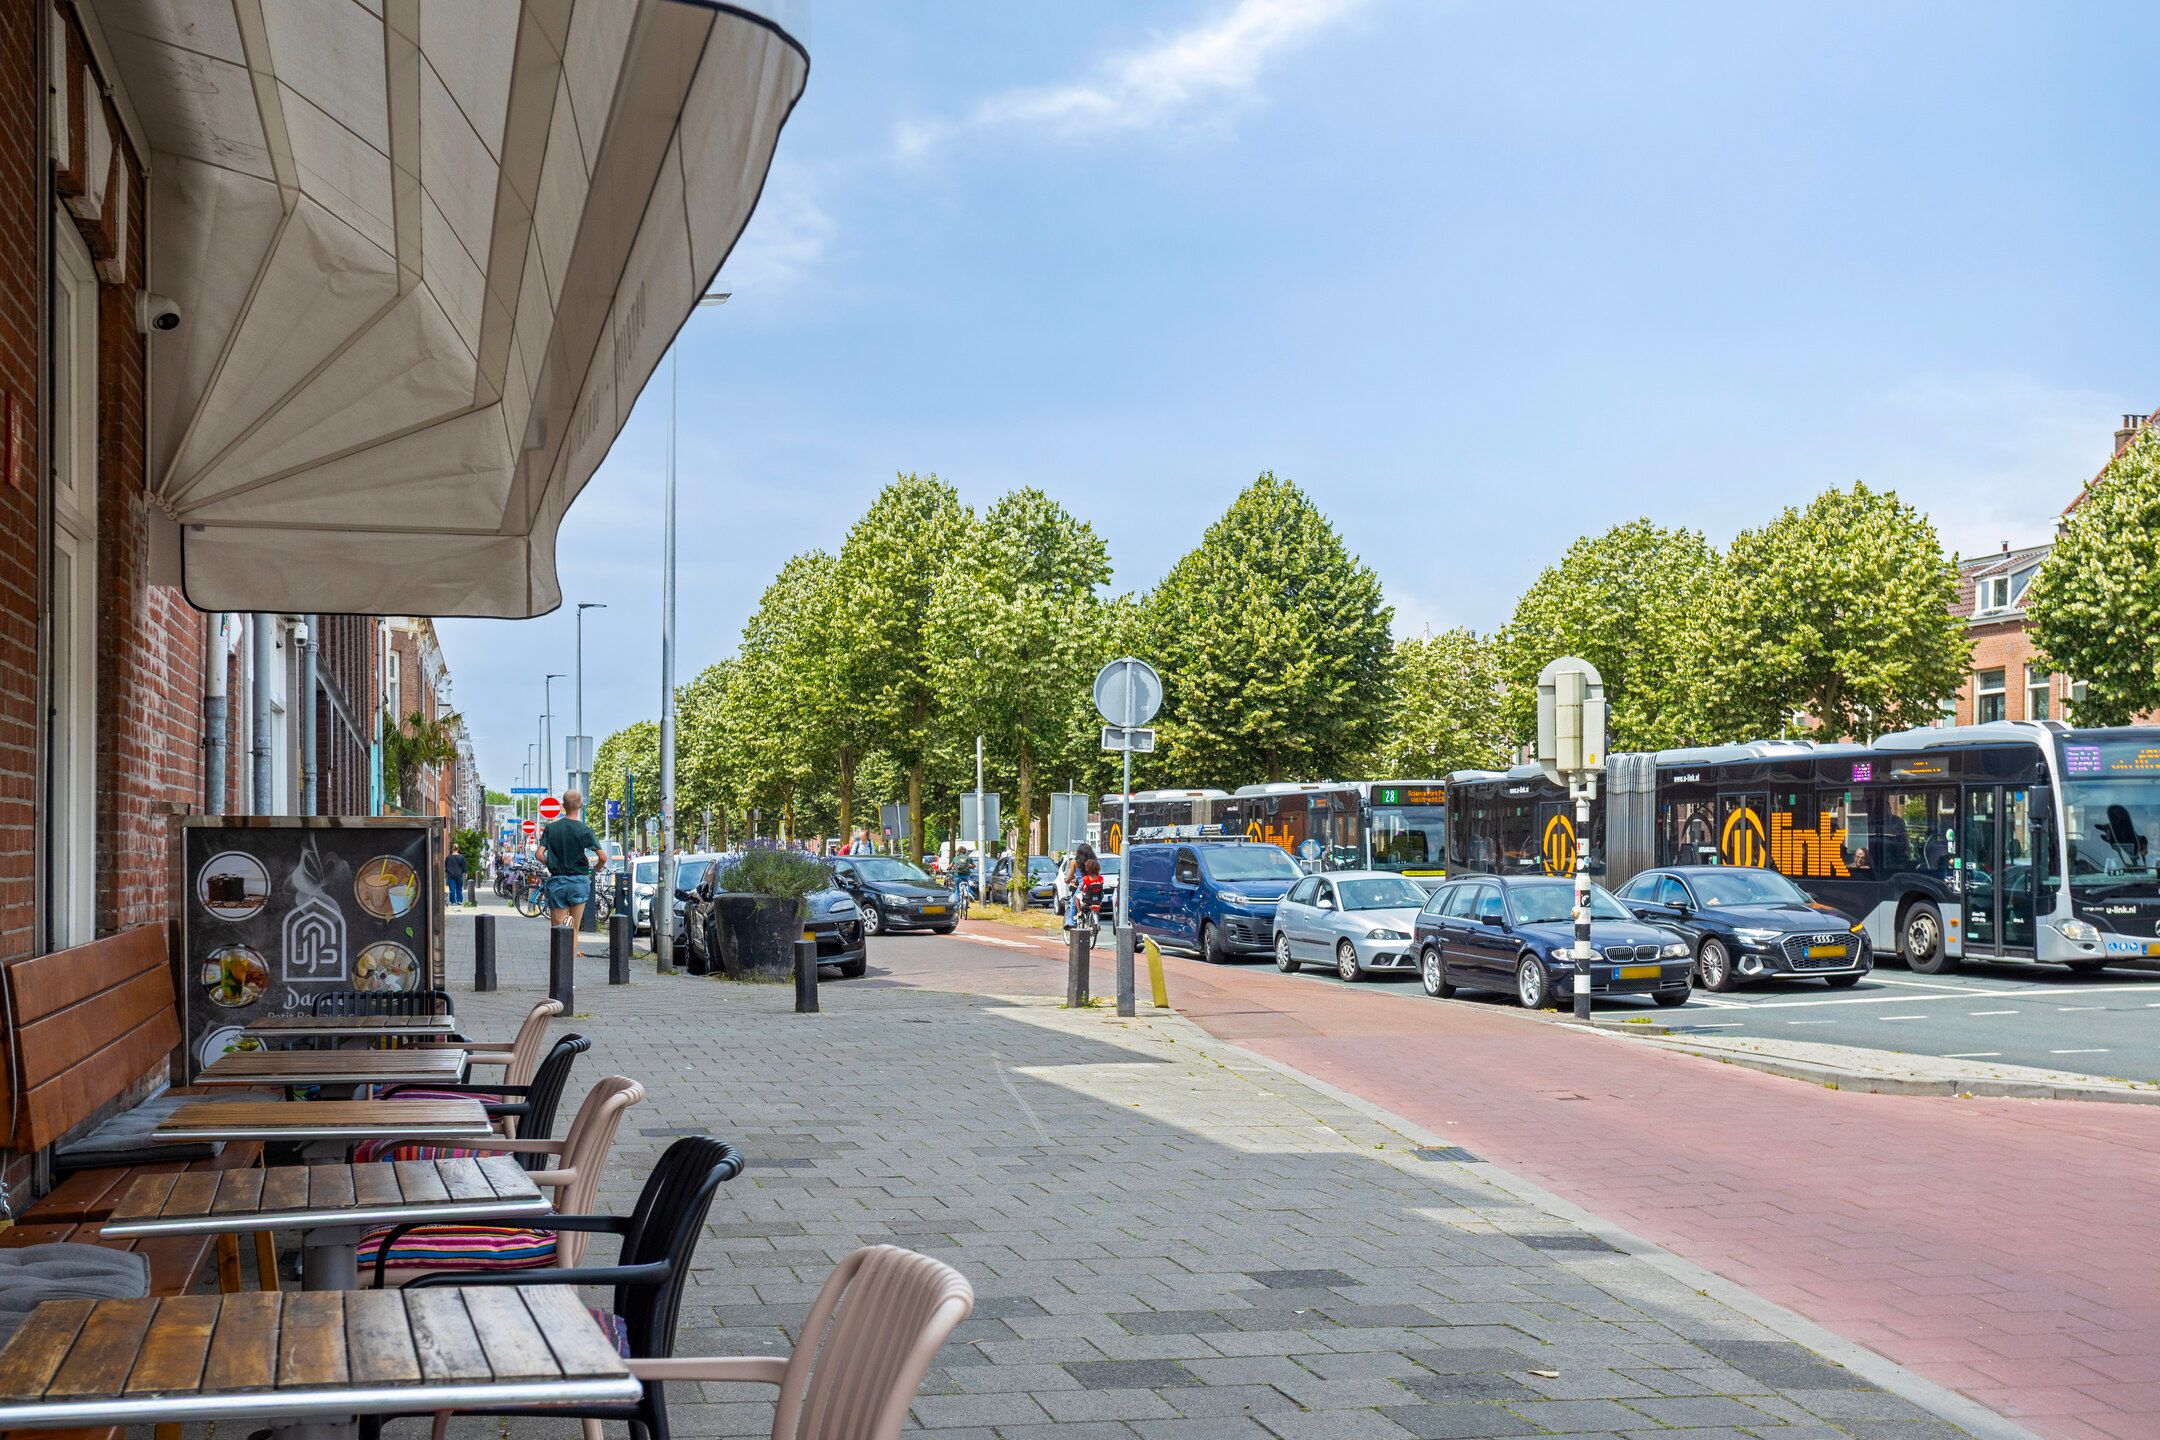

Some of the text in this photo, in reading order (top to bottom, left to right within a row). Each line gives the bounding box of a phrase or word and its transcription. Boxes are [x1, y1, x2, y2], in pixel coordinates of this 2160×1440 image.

[1385, 790, 1395, 802] 28
[1771, 812, 1851, 876] link
[2106, 905, 2136, 914] u-link.nl
